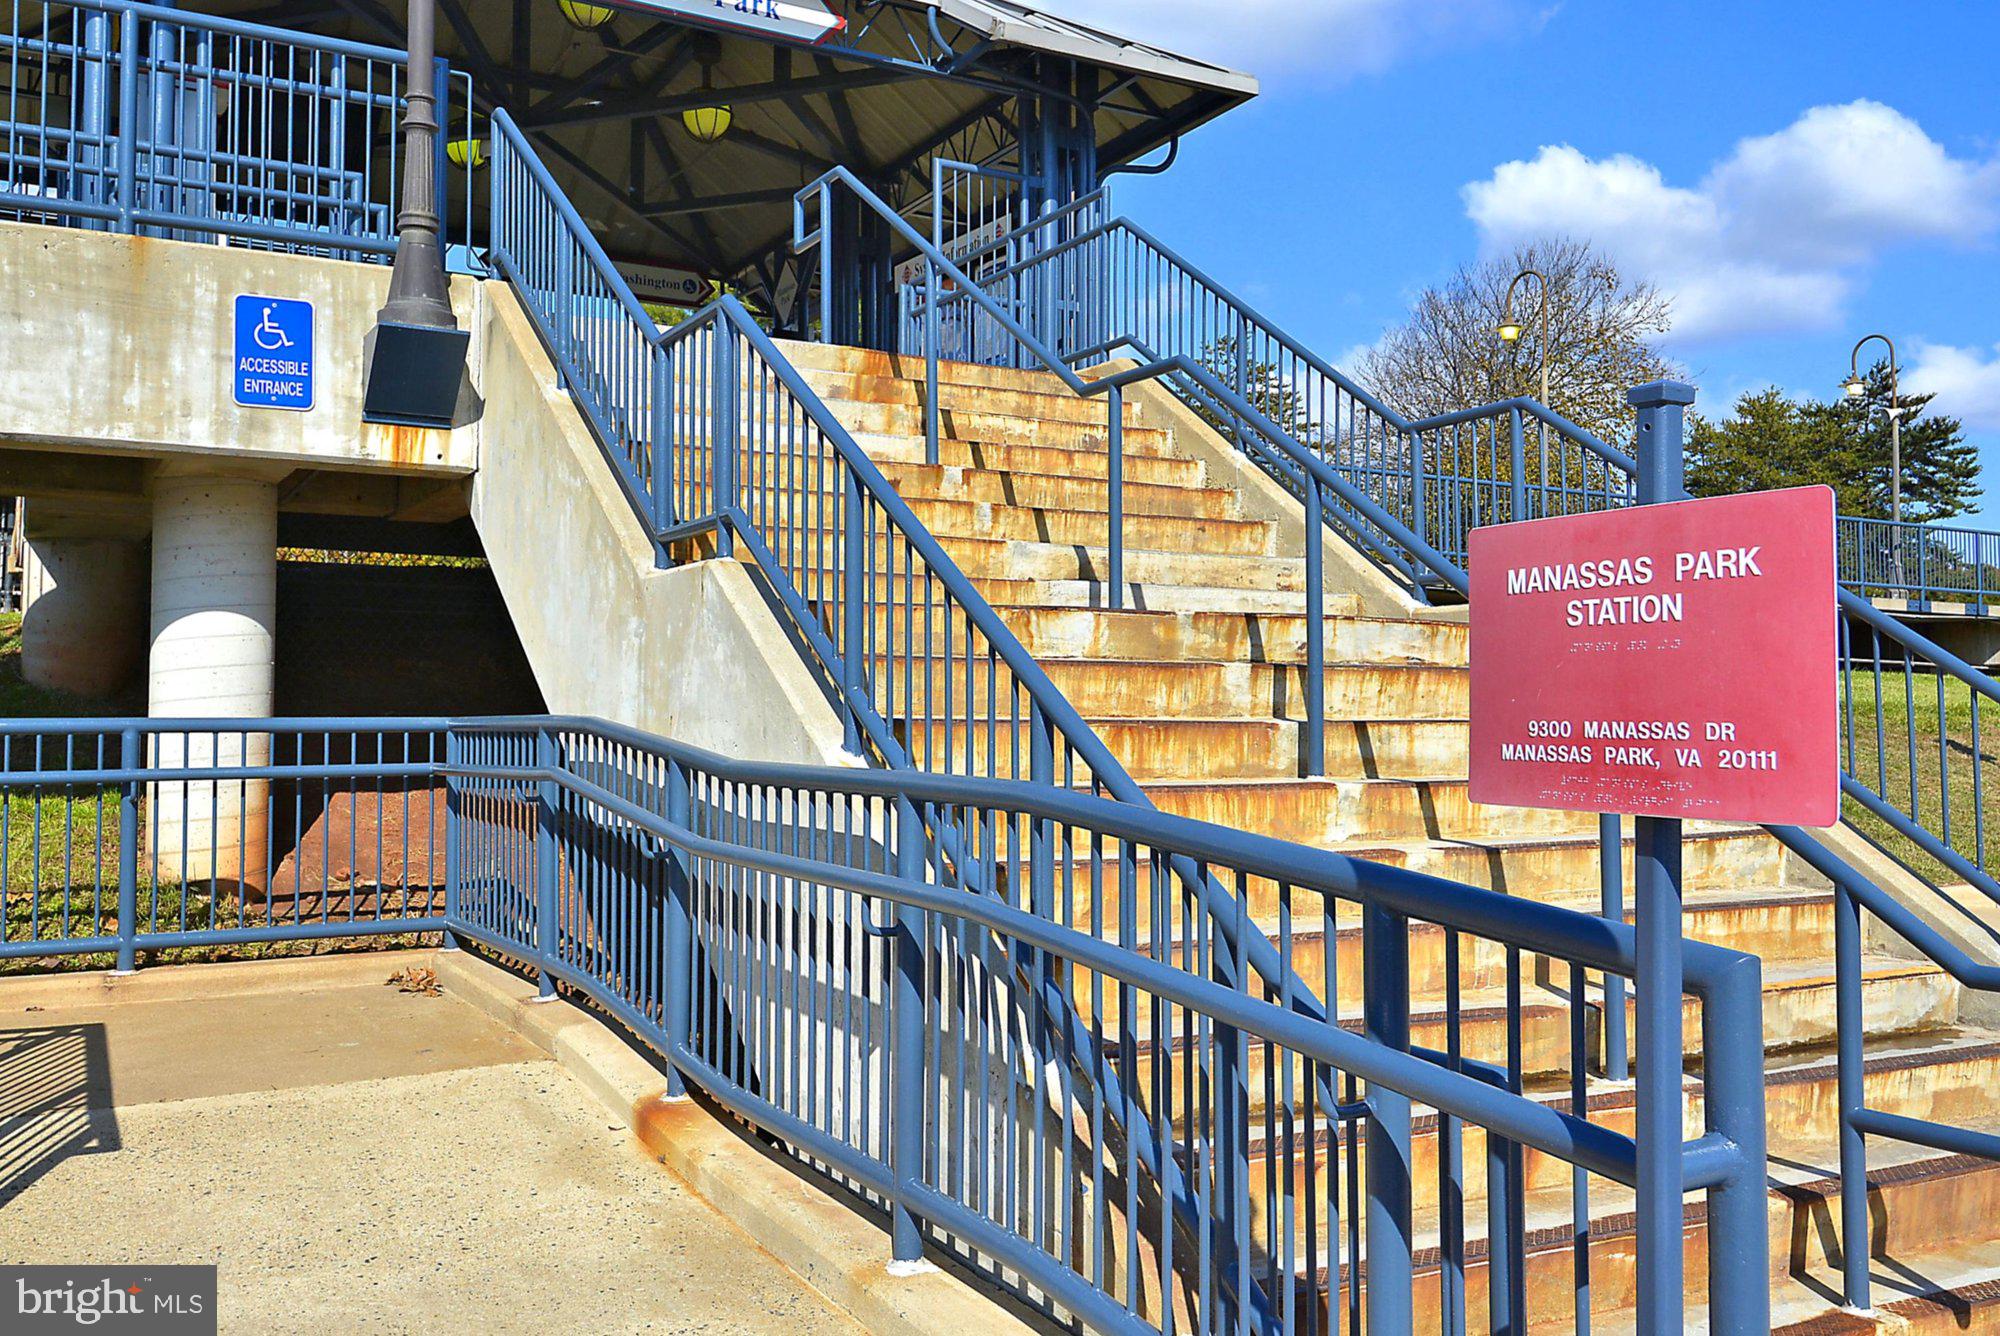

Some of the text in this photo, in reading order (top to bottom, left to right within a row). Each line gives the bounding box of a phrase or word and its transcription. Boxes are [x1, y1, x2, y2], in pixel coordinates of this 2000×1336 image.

[714, 0, 781, 20] ark
[621, 271, 680, 290] ashington
[239, 357, 309, 376] ACCESSIBLE
[244, 378, 303, 397] ENTRANCE
[1507, 546, 1762, 595] MANASSAS PARK
[1566, 592, 1683, 627] STATION
[1528, 720, 1736, 742] 9300 MANASSAS DR
[1501, 743, 1778, 770] MANASSAS PARK, VA 20111
